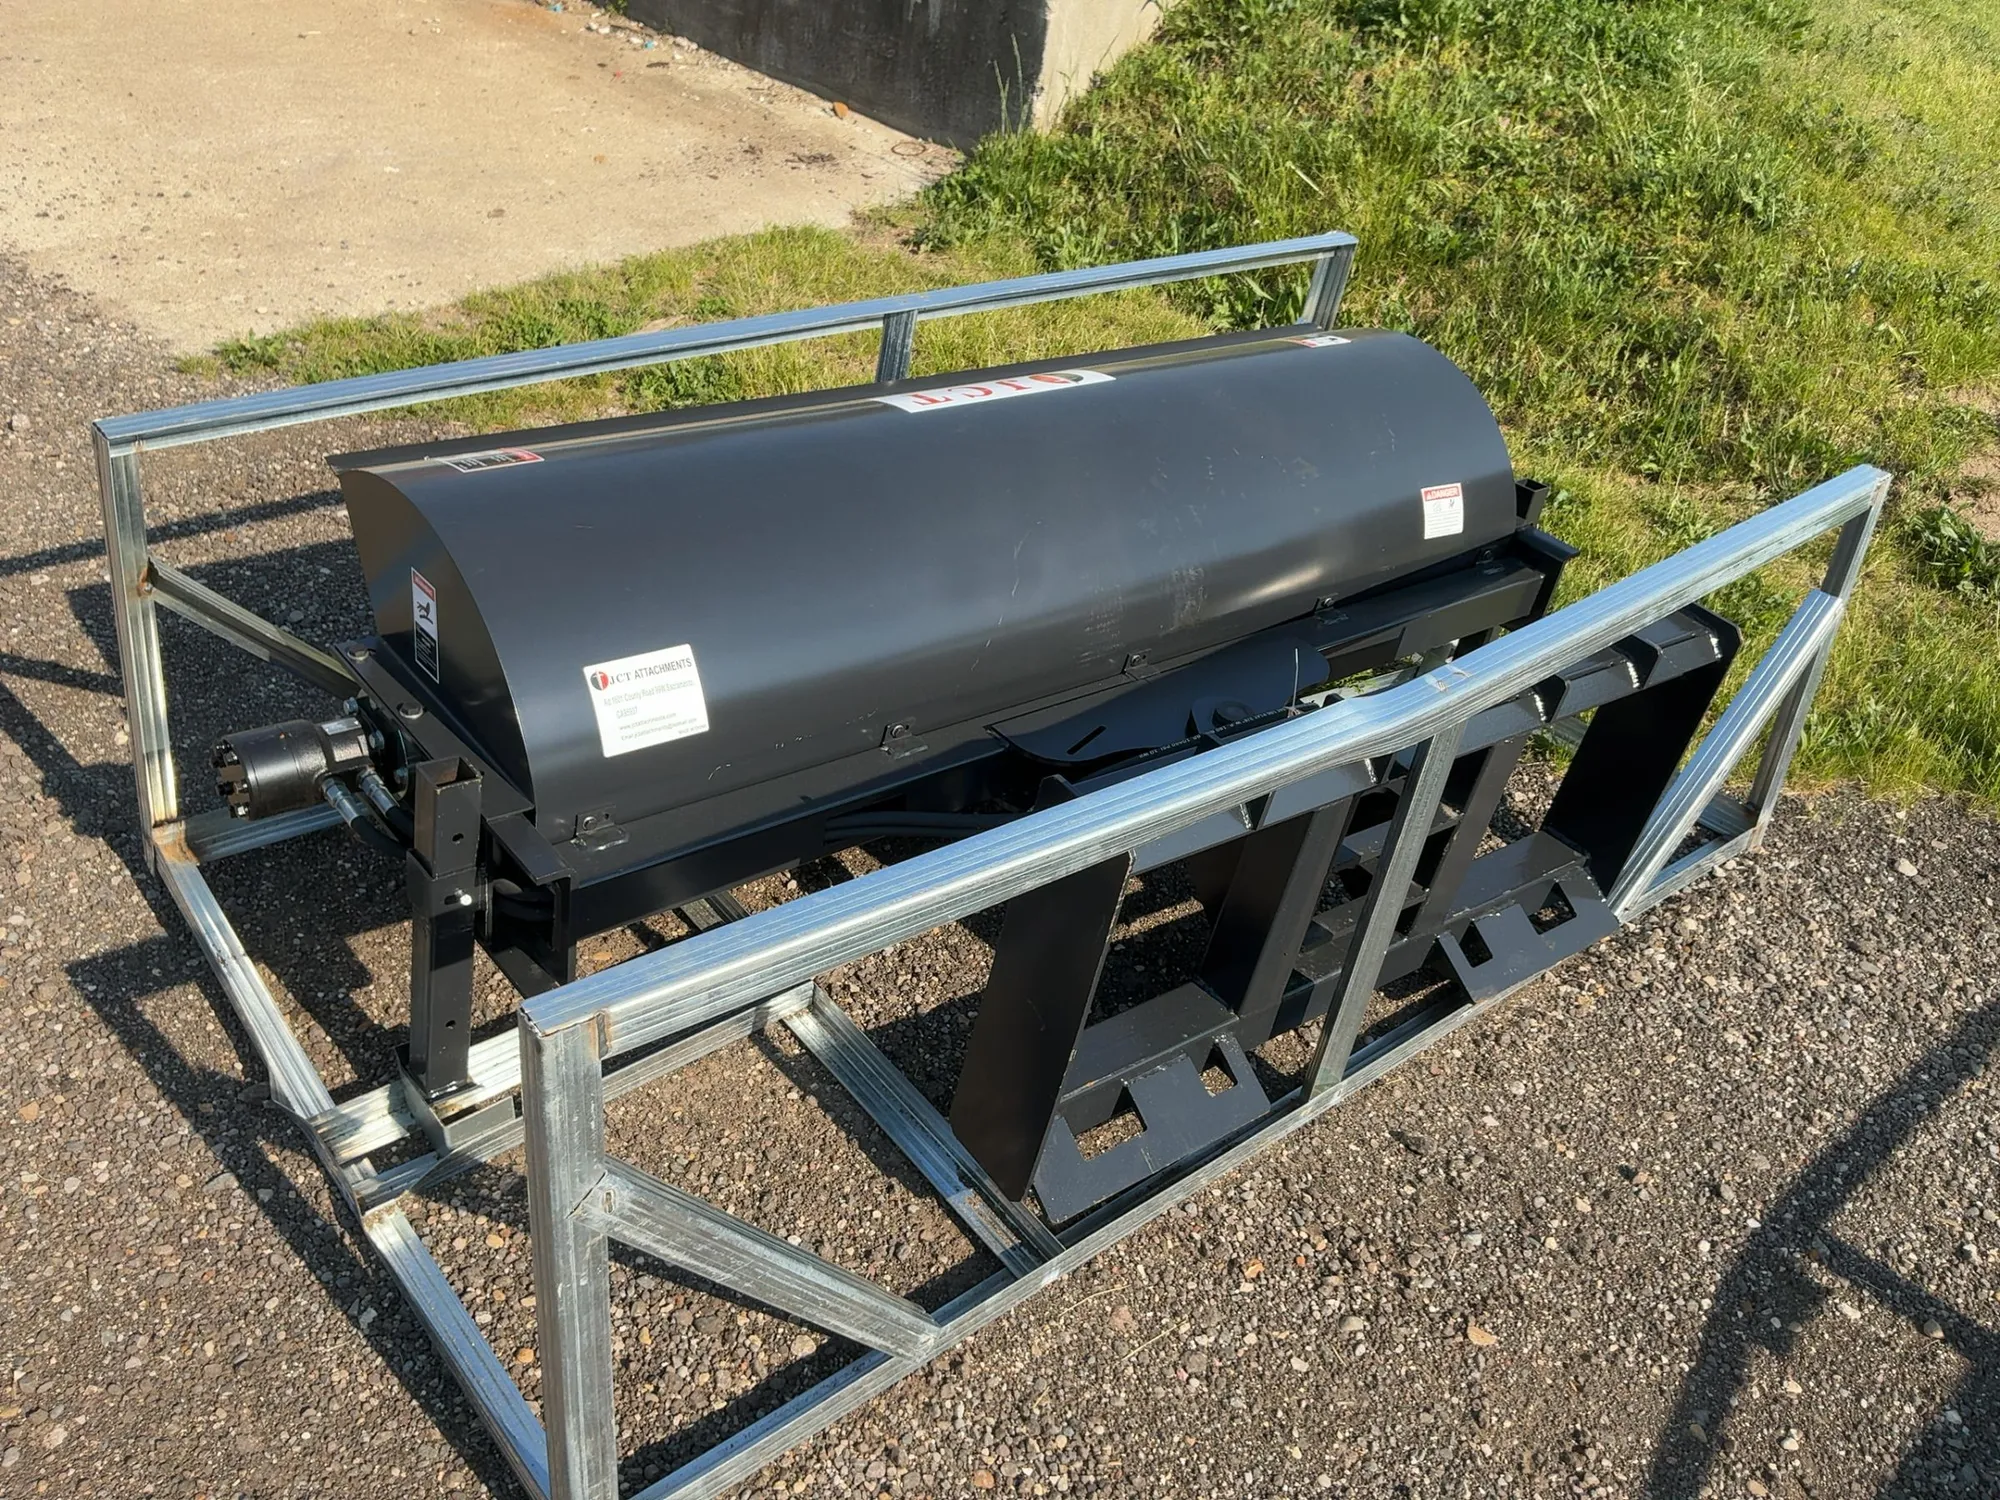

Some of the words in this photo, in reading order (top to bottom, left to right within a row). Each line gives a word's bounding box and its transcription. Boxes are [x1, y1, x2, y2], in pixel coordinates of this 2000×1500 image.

[908, 378, 1032, 406] JCT
[609, 671, 632, 685] JCT
[634, 657, 692, 680] ATTACHMENTS
